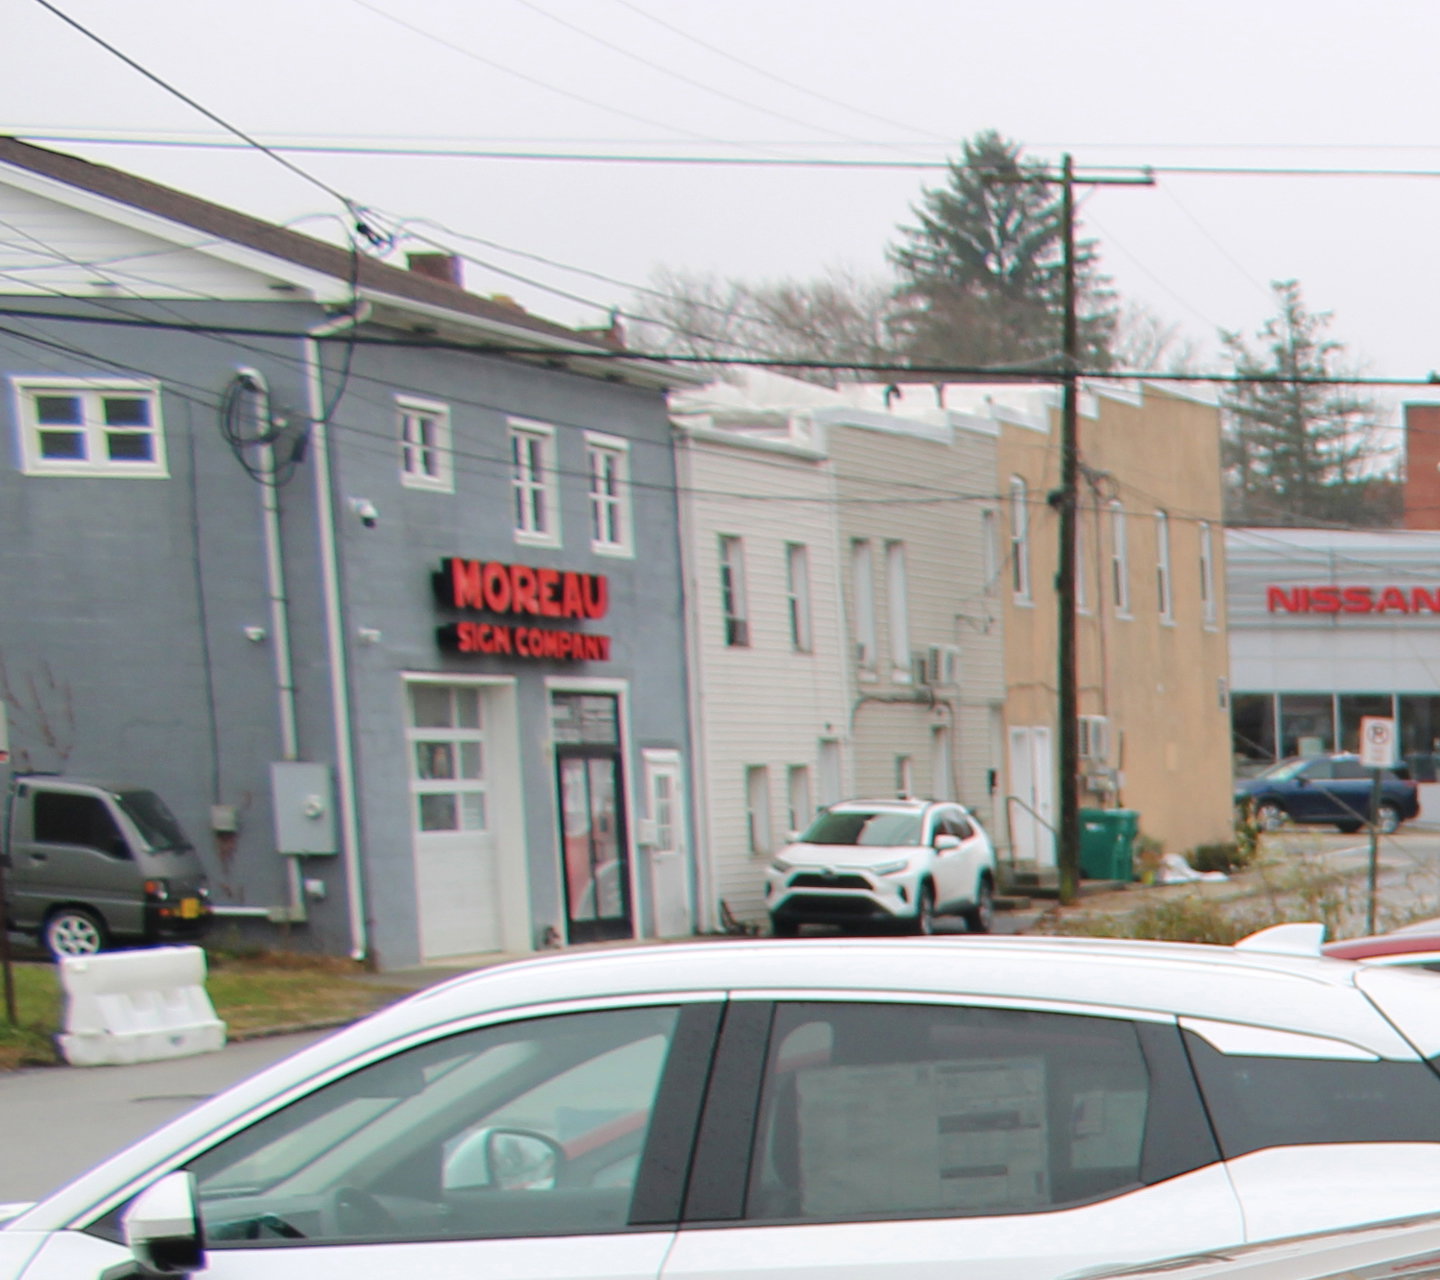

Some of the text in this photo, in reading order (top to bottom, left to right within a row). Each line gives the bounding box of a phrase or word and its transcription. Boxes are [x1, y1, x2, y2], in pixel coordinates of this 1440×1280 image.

[452, 556, 609, 620] MOREAU
[457, 621, 612, 662] SIGN COMPANY
